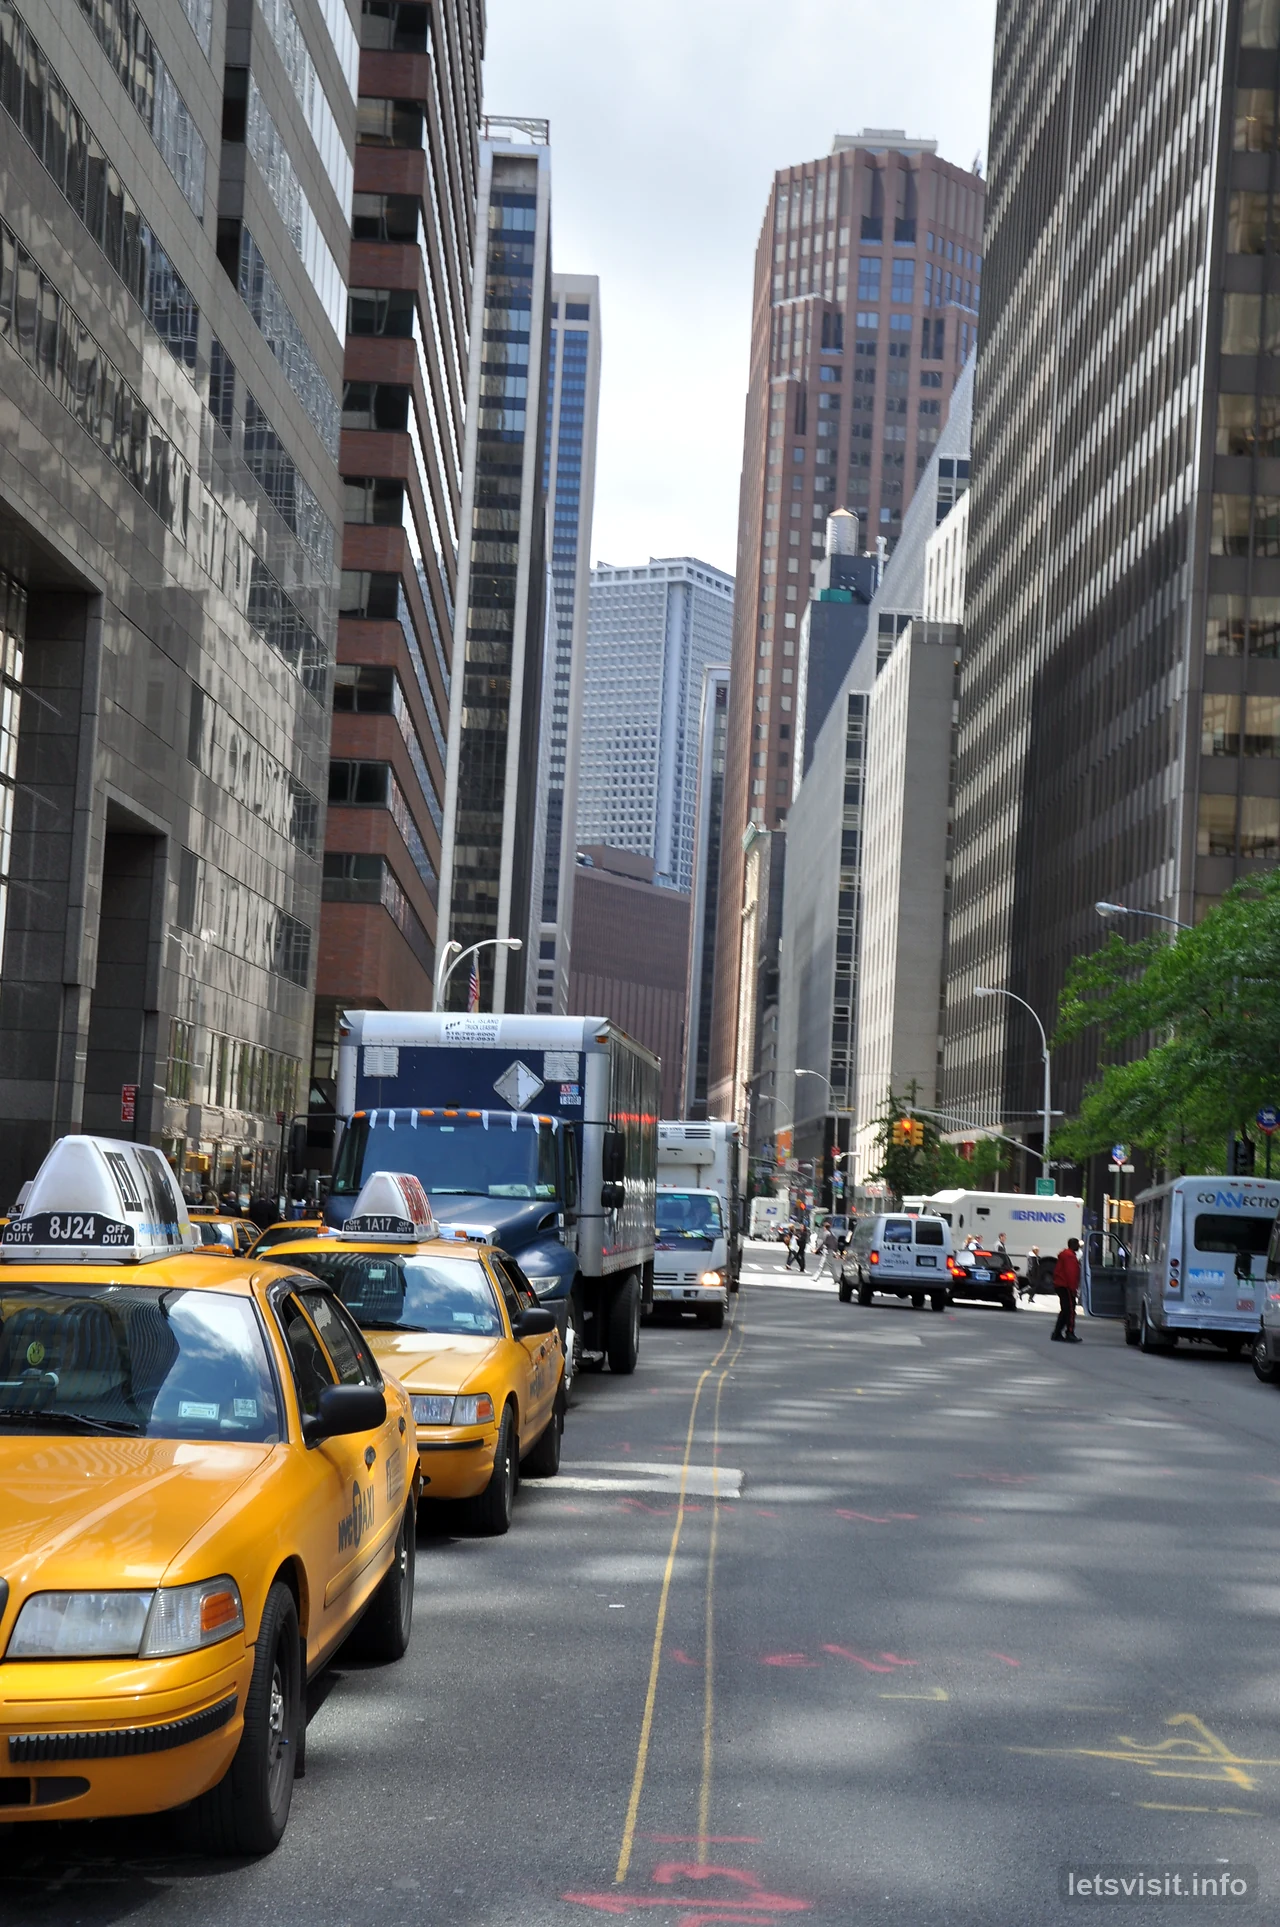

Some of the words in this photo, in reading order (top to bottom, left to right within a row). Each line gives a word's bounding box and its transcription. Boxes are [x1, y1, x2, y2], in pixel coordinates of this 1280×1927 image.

[1197, 1191, 1280, 1209] CONNECTIO
[12, 1222, 33, 1233] OFF
[49, 1215, 95, 1240] 8J24
[106, 1223, 127, 1234] OFF
[366, 1217, 392, 1231] 1A17
[6, 1232, 34, 1243] DUTY
[102, 1233, 130, 1245] DUTY
[338, 1514, 352, 1554] NYC
[352, 1480, 375, 1548] TAXI
